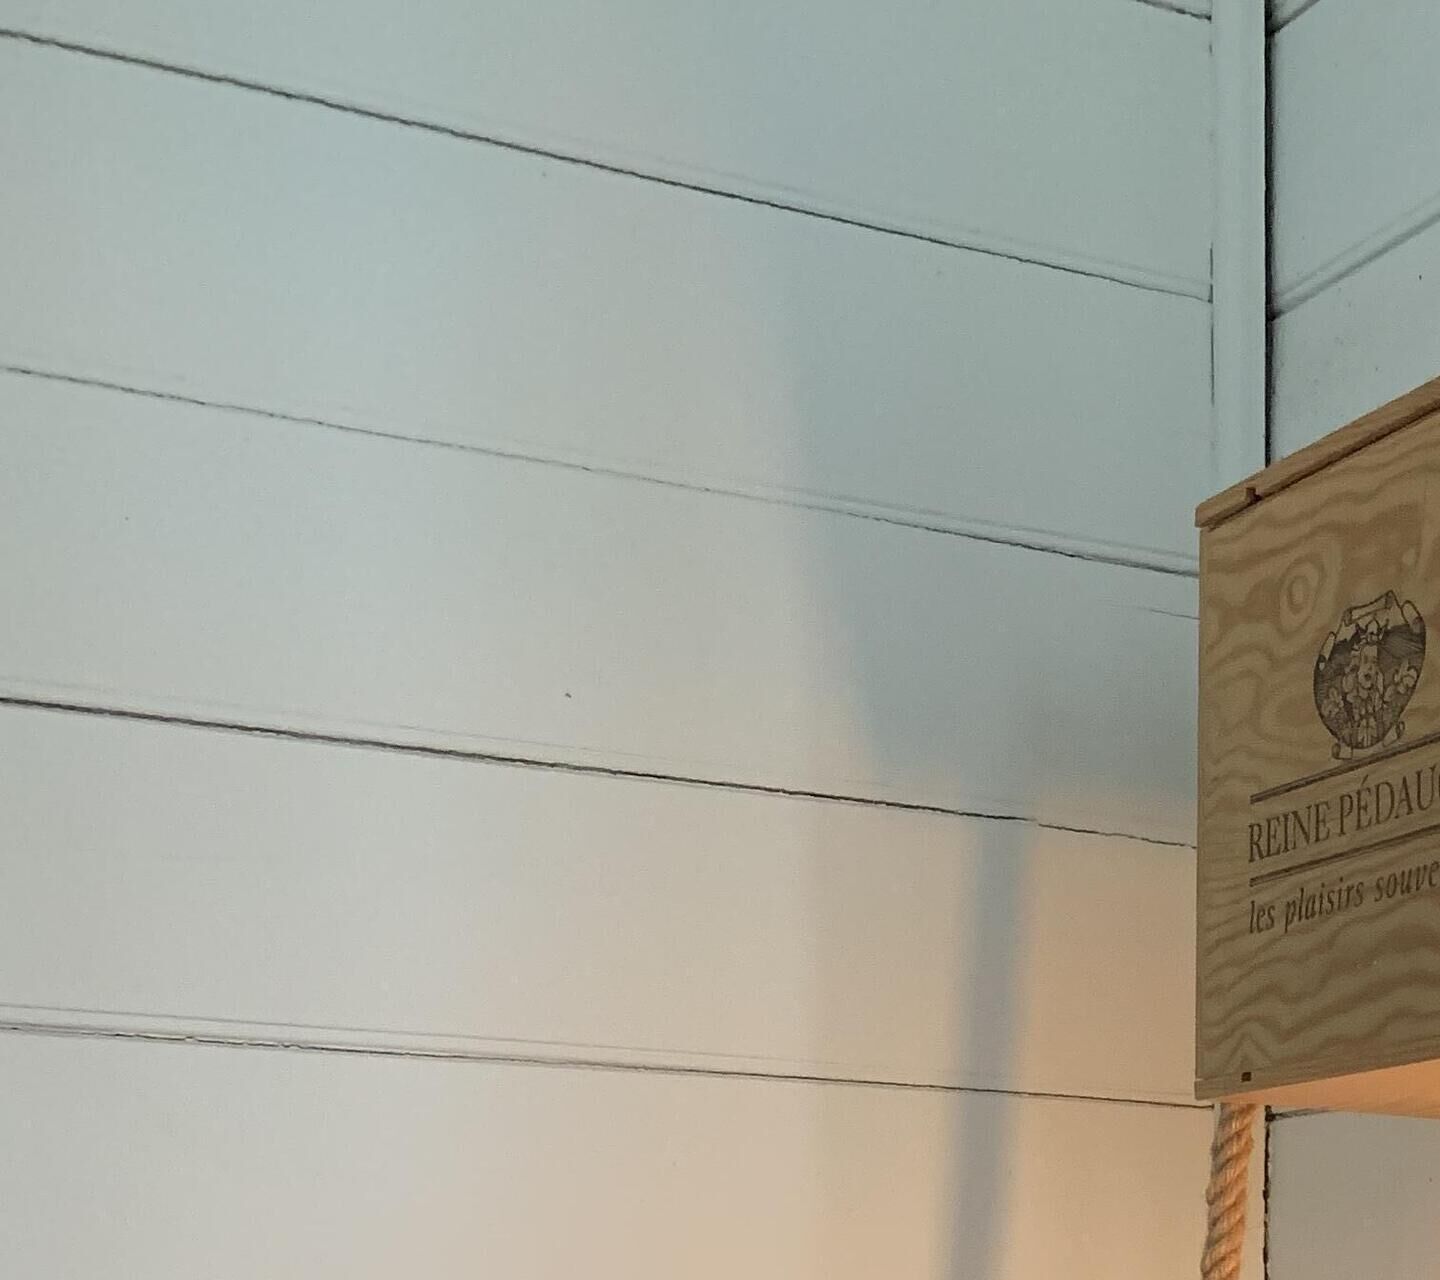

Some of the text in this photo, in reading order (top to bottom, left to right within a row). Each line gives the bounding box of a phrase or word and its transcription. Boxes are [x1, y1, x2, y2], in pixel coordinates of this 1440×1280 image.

[1248, 801, 1330, 863] REINE
[1249, 899, 1275, 934] les
[1283, 876, 1364, 933] plaisirs
